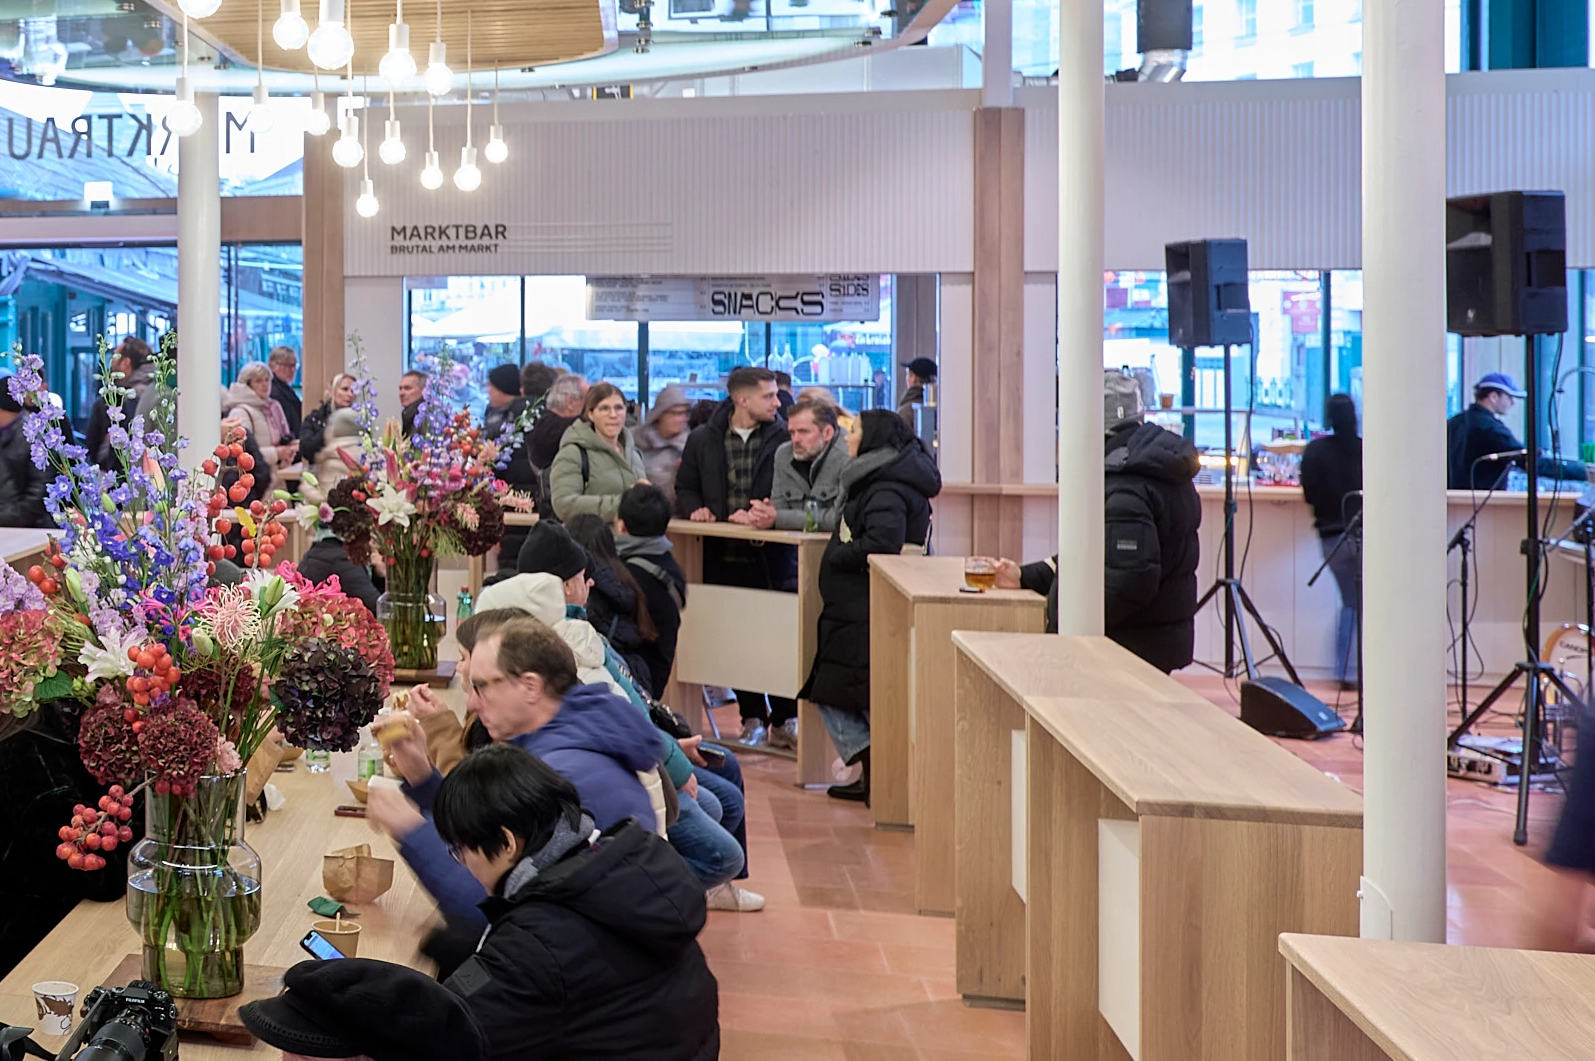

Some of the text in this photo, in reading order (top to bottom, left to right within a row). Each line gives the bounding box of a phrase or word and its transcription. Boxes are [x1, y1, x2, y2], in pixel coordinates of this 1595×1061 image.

[391, 224, 508, 241] MARKTBAR
[390, 243, 499, 255] BRUTAL AM MARKT
[711, 291, 824, 316] SNACKS
